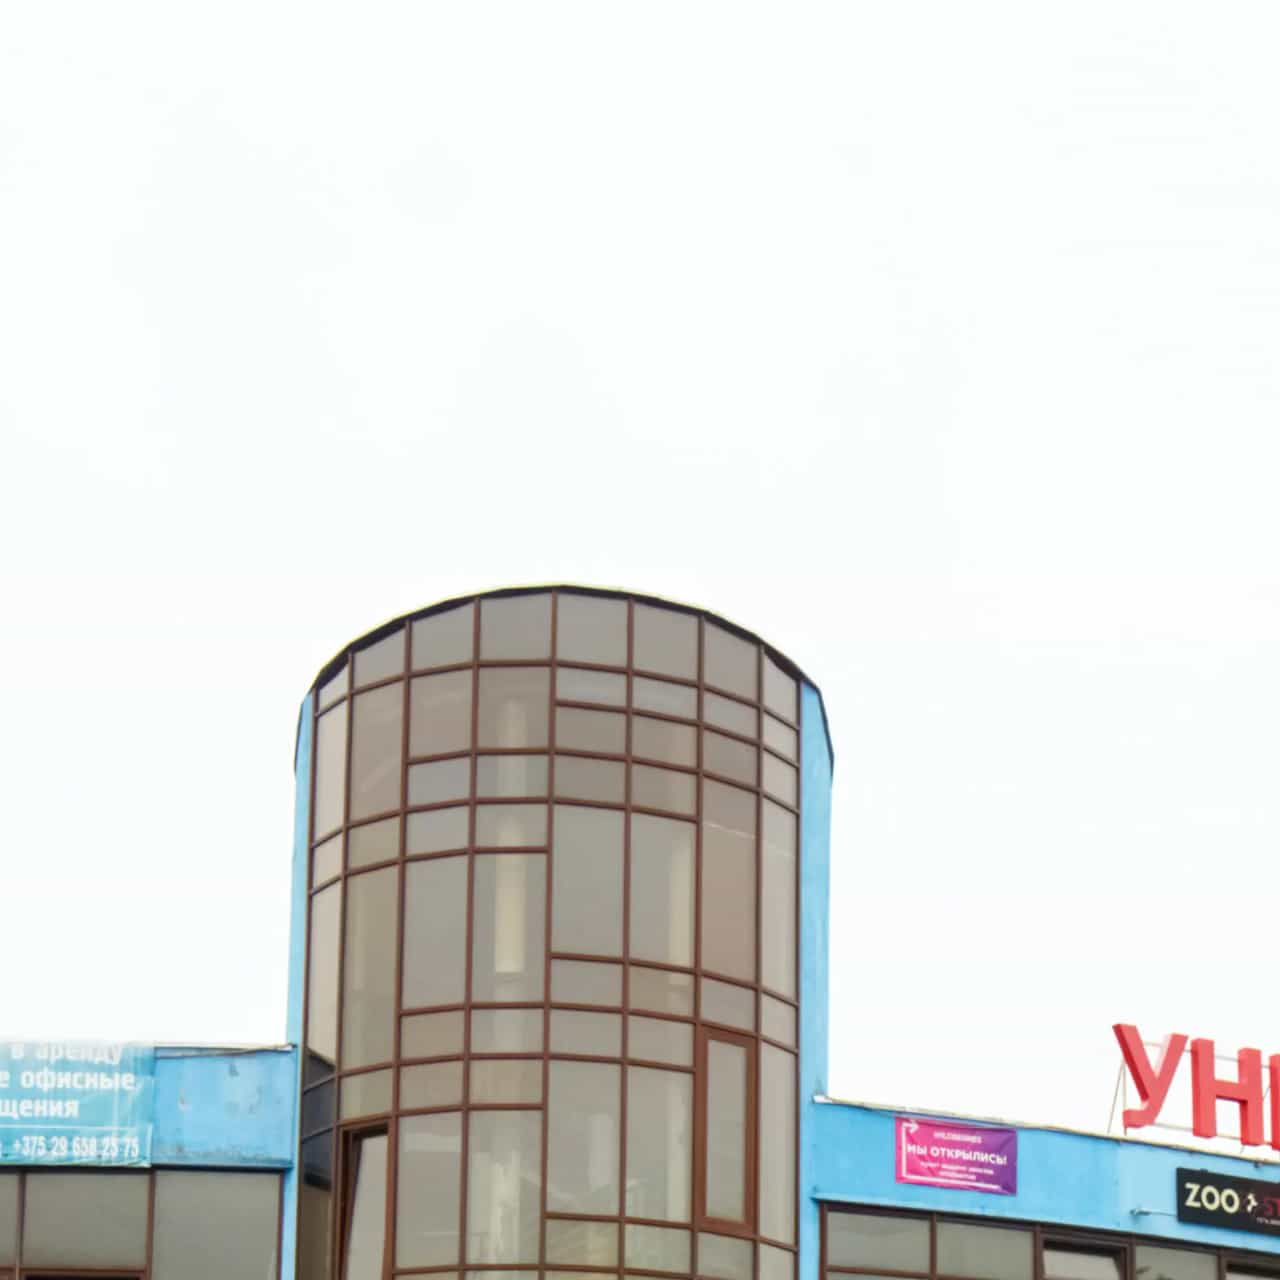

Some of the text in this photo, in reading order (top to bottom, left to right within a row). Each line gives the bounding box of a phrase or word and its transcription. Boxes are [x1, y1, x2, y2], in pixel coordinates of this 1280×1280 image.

[906, 1142, 1008, 1166] МЫ ОТКРЫЛИСЬ!
[1184, 1181, 1240, 1214] ZOO
